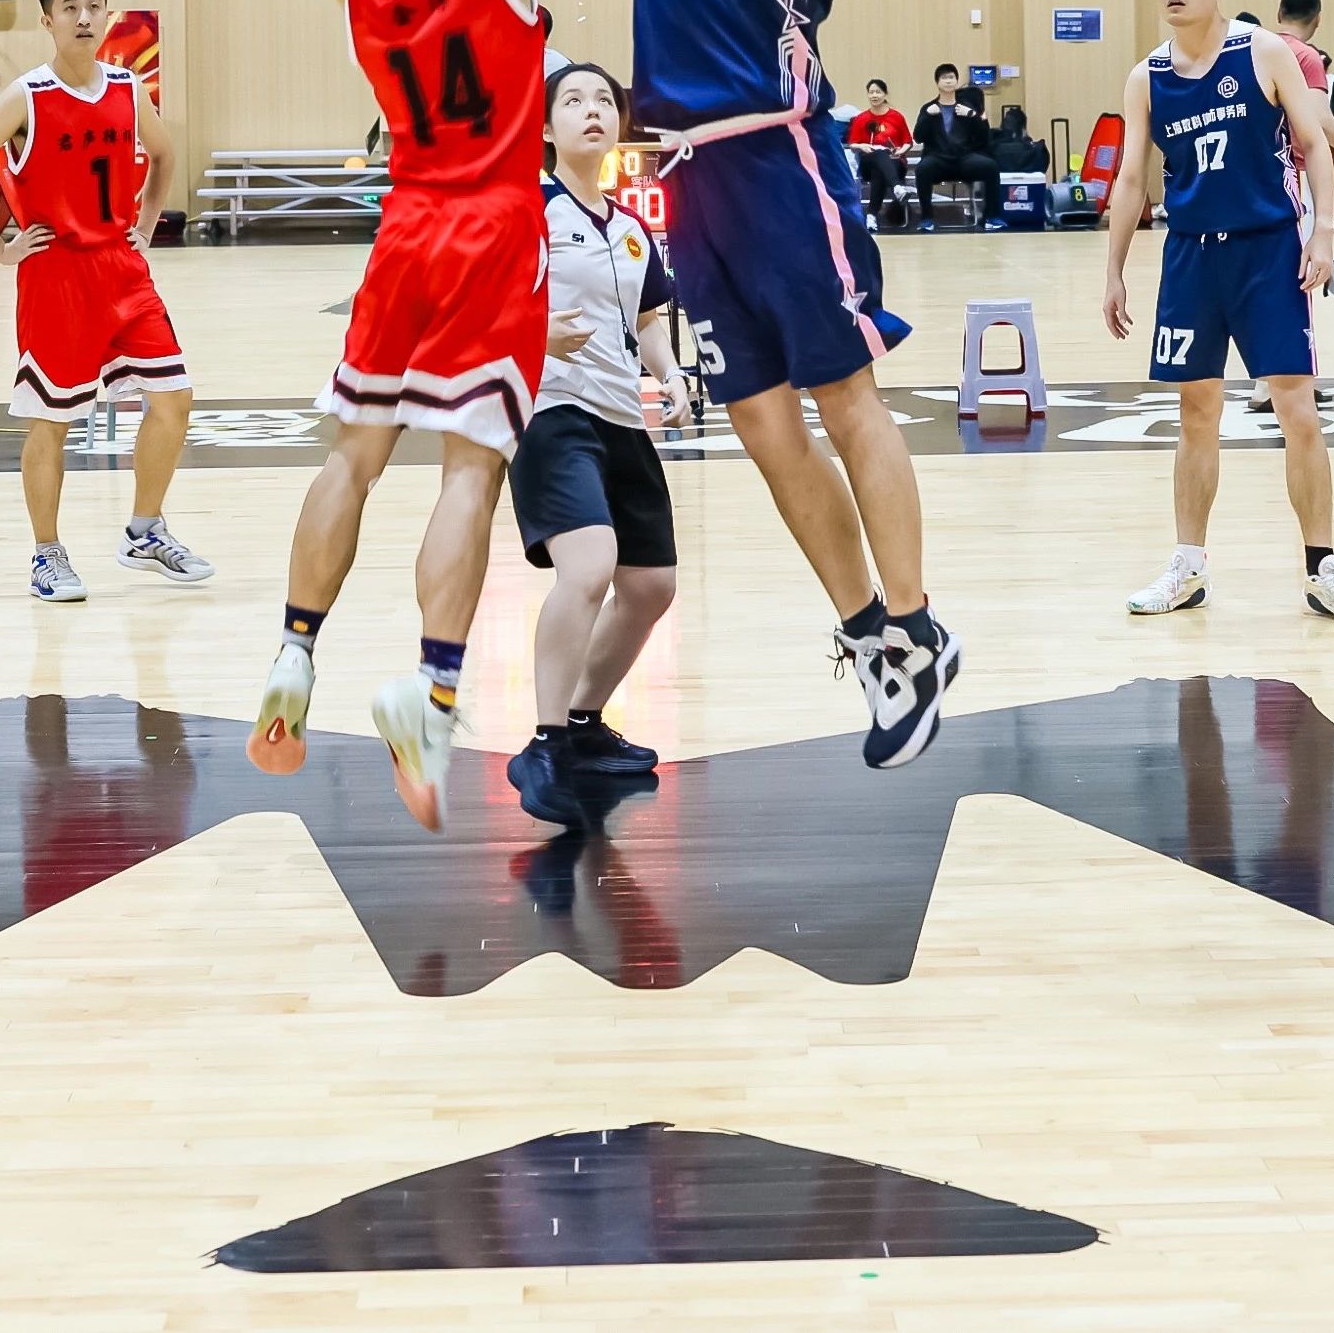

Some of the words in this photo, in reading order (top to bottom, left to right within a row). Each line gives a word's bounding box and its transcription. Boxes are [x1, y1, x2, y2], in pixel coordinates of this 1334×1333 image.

[387, 32, 493, 147] 14
[1194, 130, 1228, 174] 07
[91, 156, 114, 222] 1
[630, 175, 655, 187] 客队
[1156, 325, 1195, 365] 07
